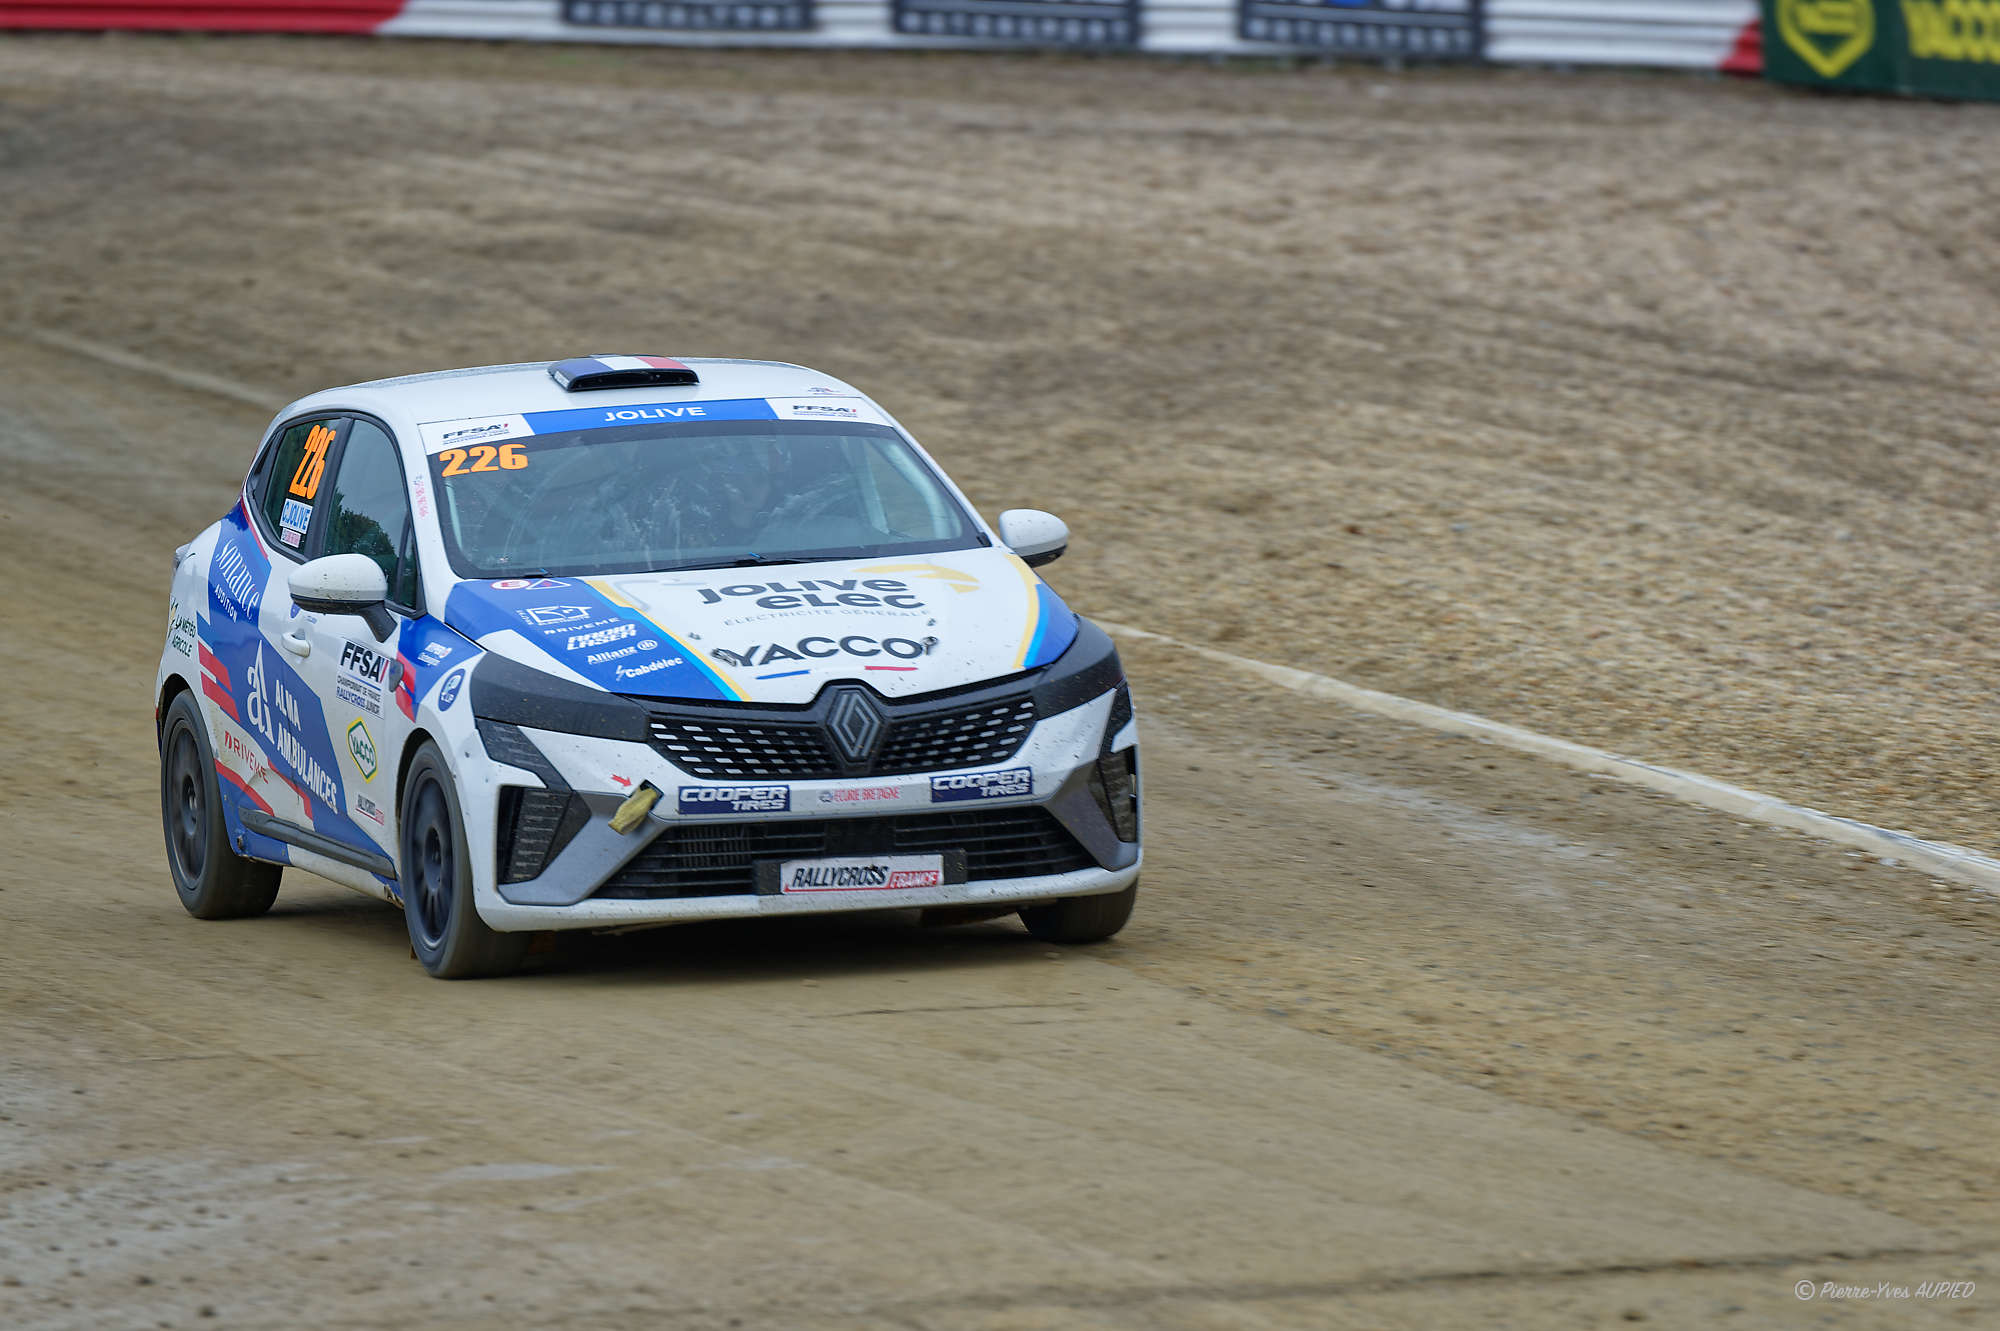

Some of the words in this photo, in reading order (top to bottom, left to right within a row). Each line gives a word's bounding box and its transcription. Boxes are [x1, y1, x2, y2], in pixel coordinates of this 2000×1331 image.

[605, 407, 706, 421] JOLIVE
[289, 424, 336, 499] 226
[439, 443, 528, 478] 226
[215, 584, 237, 623] AUDITION
[172, 634, 193, 658] AGRICOLE
[587, 646, 638, 664] Allianz
[726, 635, 924, 668] YACCO
[340, 641, 383, 683] FFSA
[625, 657, 683, 678] Cabdélec
[275, 679, 301, 731] ALMA
[350, 734, 375, 767] YACCO
[277, 722, 338, 814] AMBULANCES
[933, 769, 1031, 790] COOPER
[680, 786, 787, 801] COOPER
[980, 783, 1029, 797] TIRES
[731, 800, 785, 811] TIRES
[792, 866, 890, 888] RALLYCROSS
[890, 871, 938, 889] FRANCE
